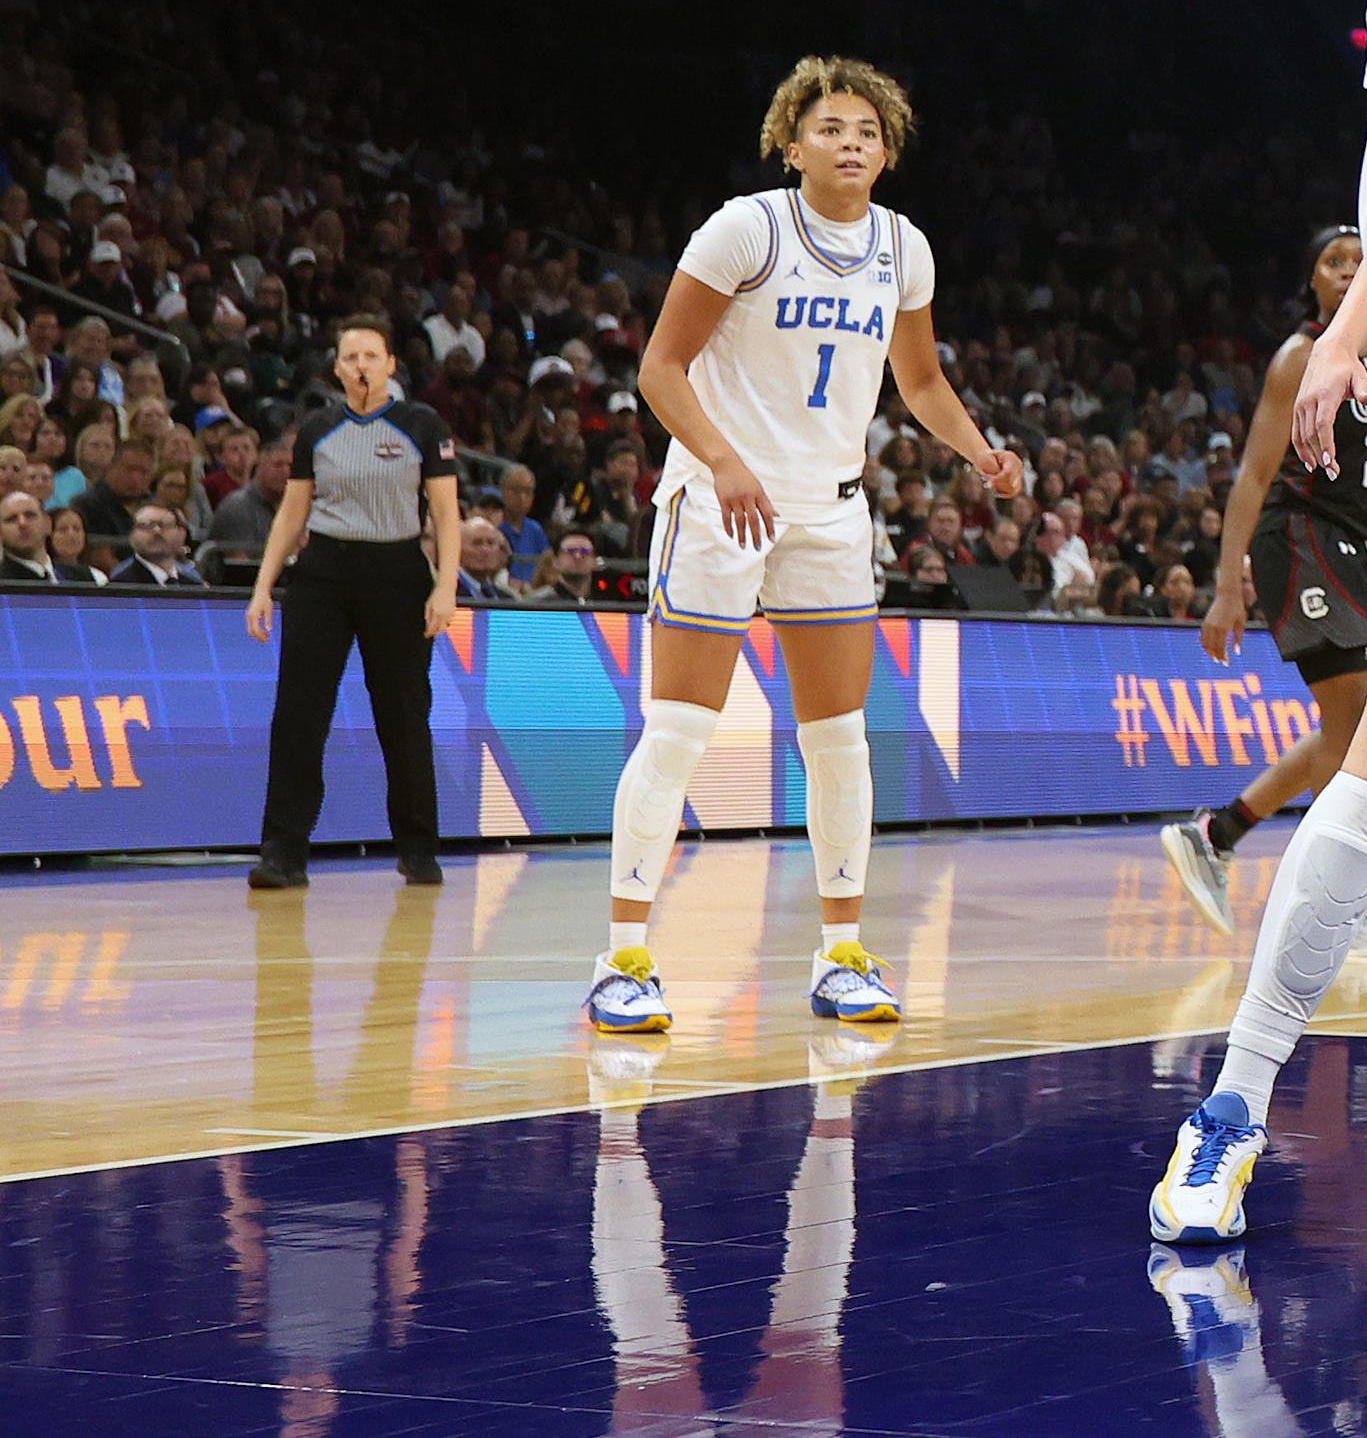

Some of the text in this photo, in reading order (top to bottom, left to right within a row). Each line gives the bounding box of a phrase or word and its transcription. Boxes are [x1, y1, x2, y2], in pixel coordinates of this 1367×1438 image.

[775, 297, 884, 342] UCLA
[807, 344, 836, 409] 1
[0, 694, 150, 793] ur
[1112, 672, 1321, 767] #WFin
